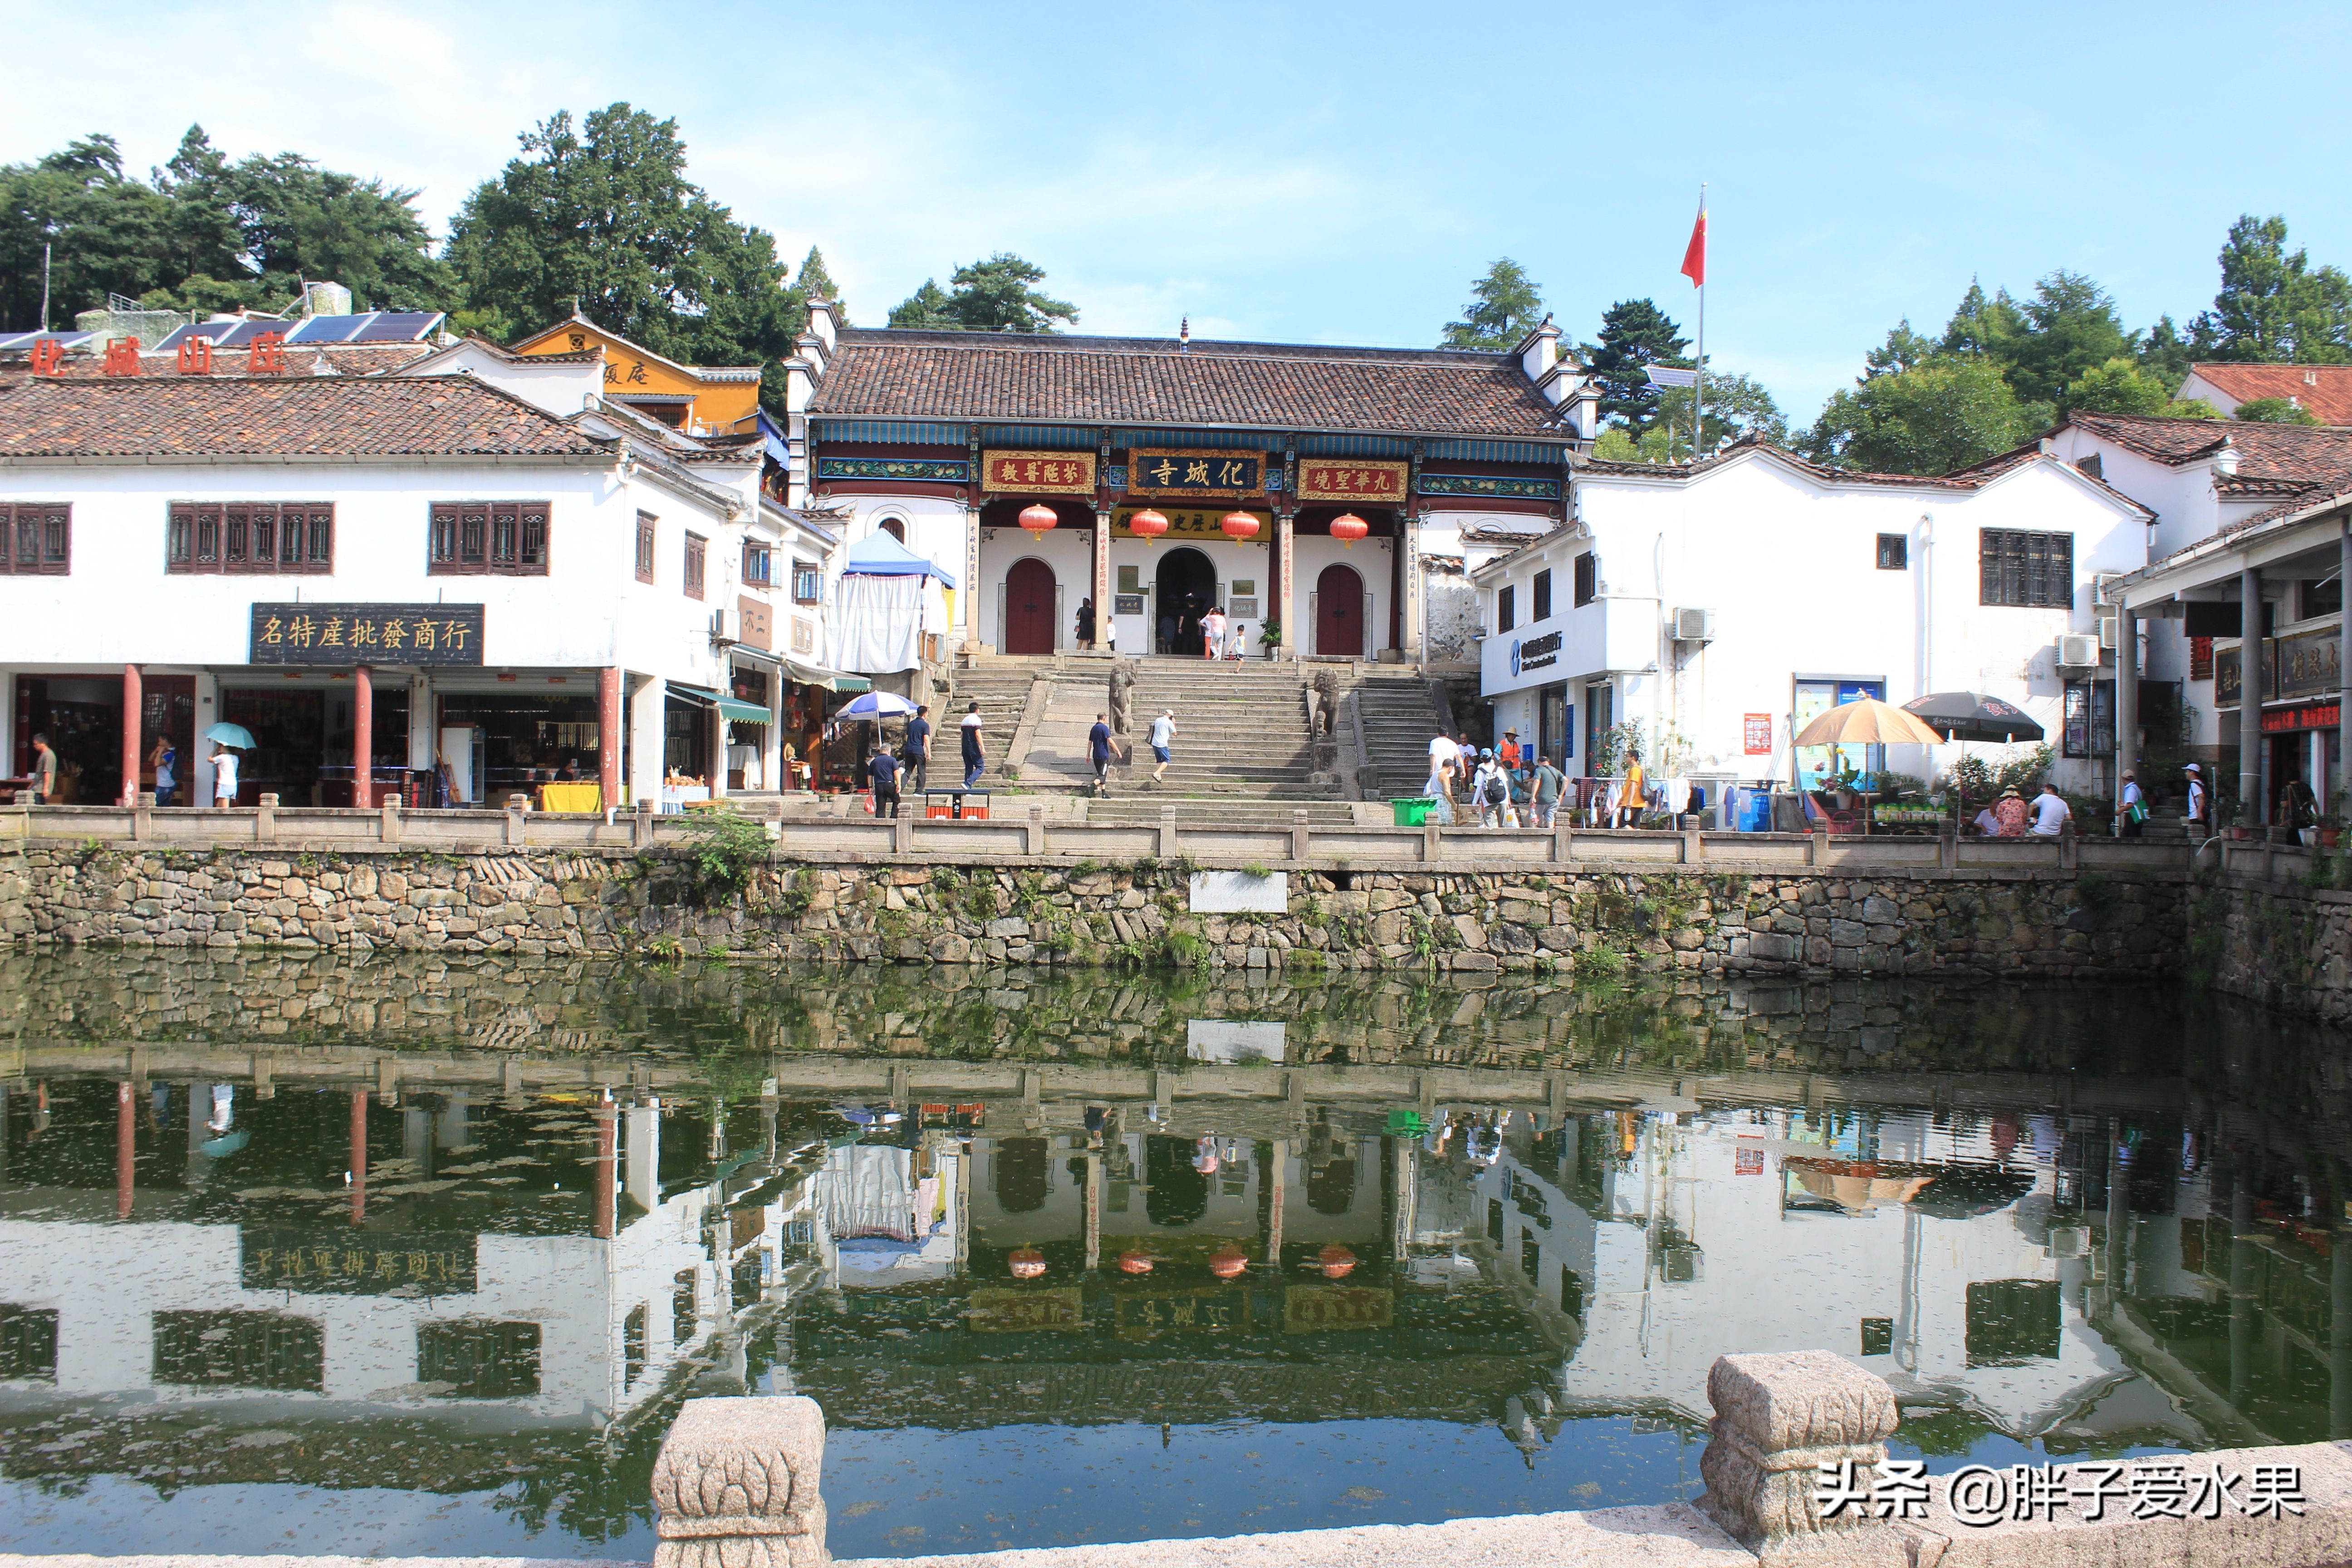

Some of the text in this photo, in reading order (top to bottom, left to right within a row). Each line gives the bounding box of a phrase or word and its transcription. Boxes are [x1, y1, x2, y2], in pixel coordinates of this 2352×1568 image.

[29, 331, 285, 377] 化城山庄
[1150, 459, 1244, 486] 化城寺
